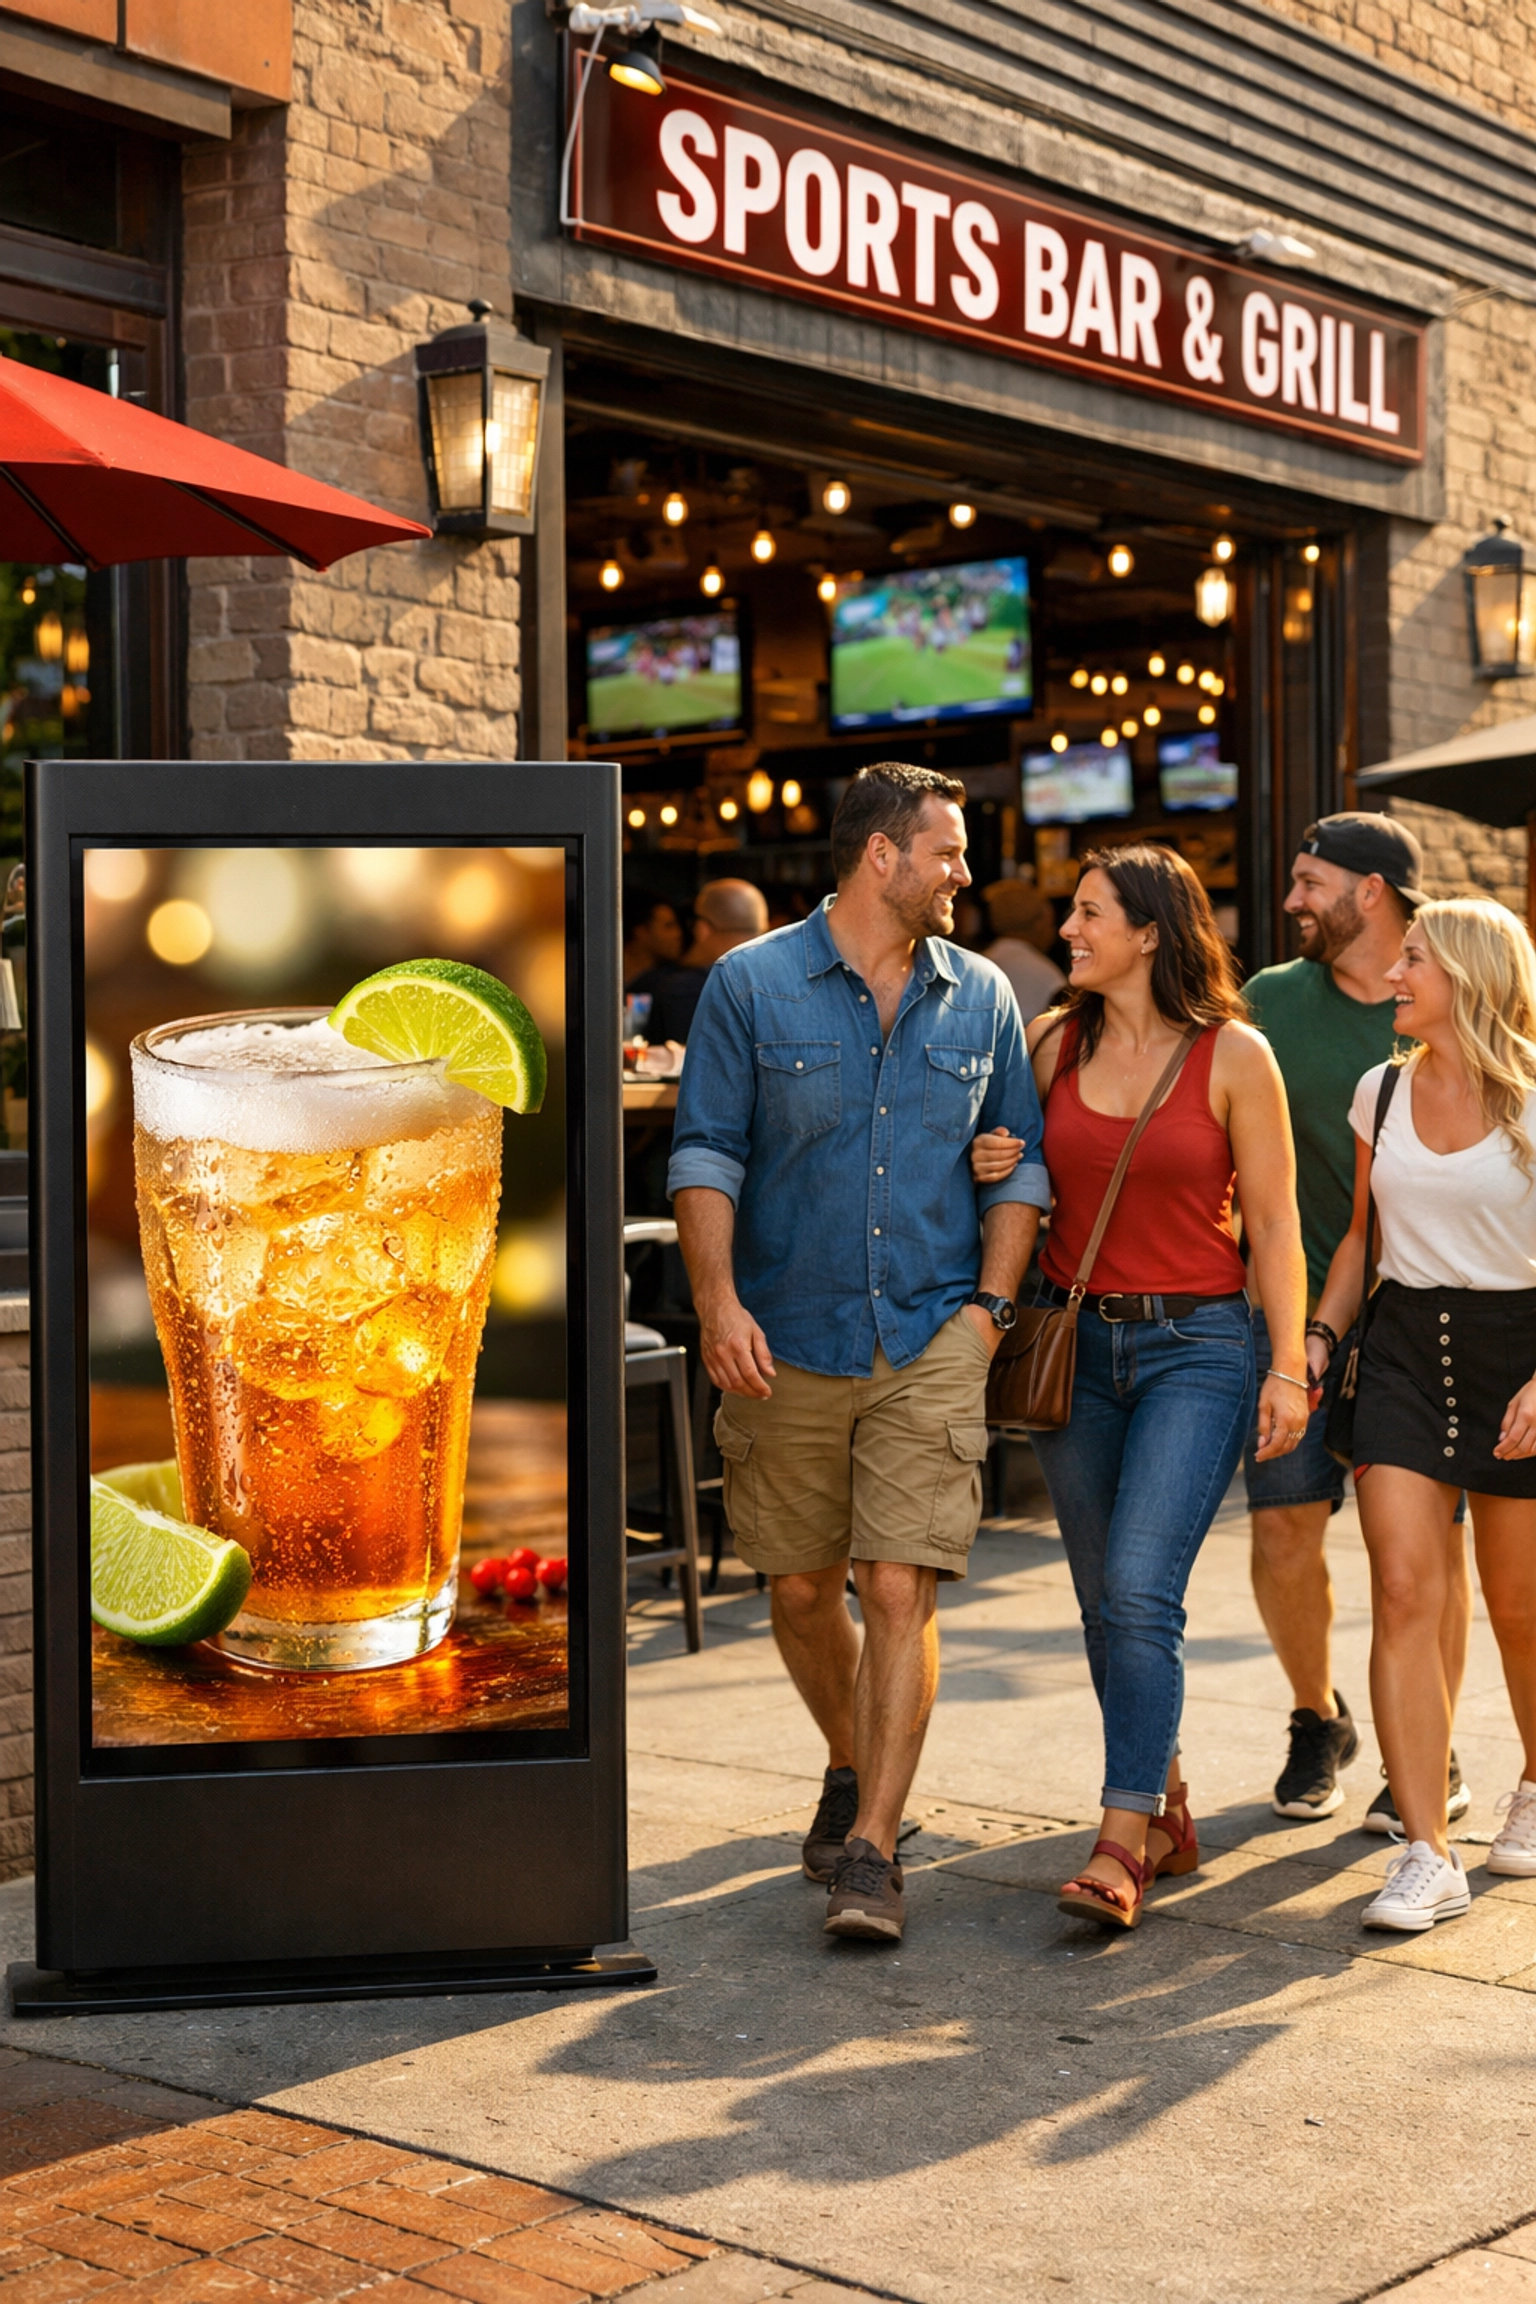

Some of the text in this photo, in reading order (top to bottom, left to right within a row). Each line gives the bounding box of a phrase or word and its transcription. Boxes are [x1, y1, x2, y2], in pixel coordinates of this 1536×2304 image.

[656, 109, 1400, 435] SPORTS BAR & GRILL
